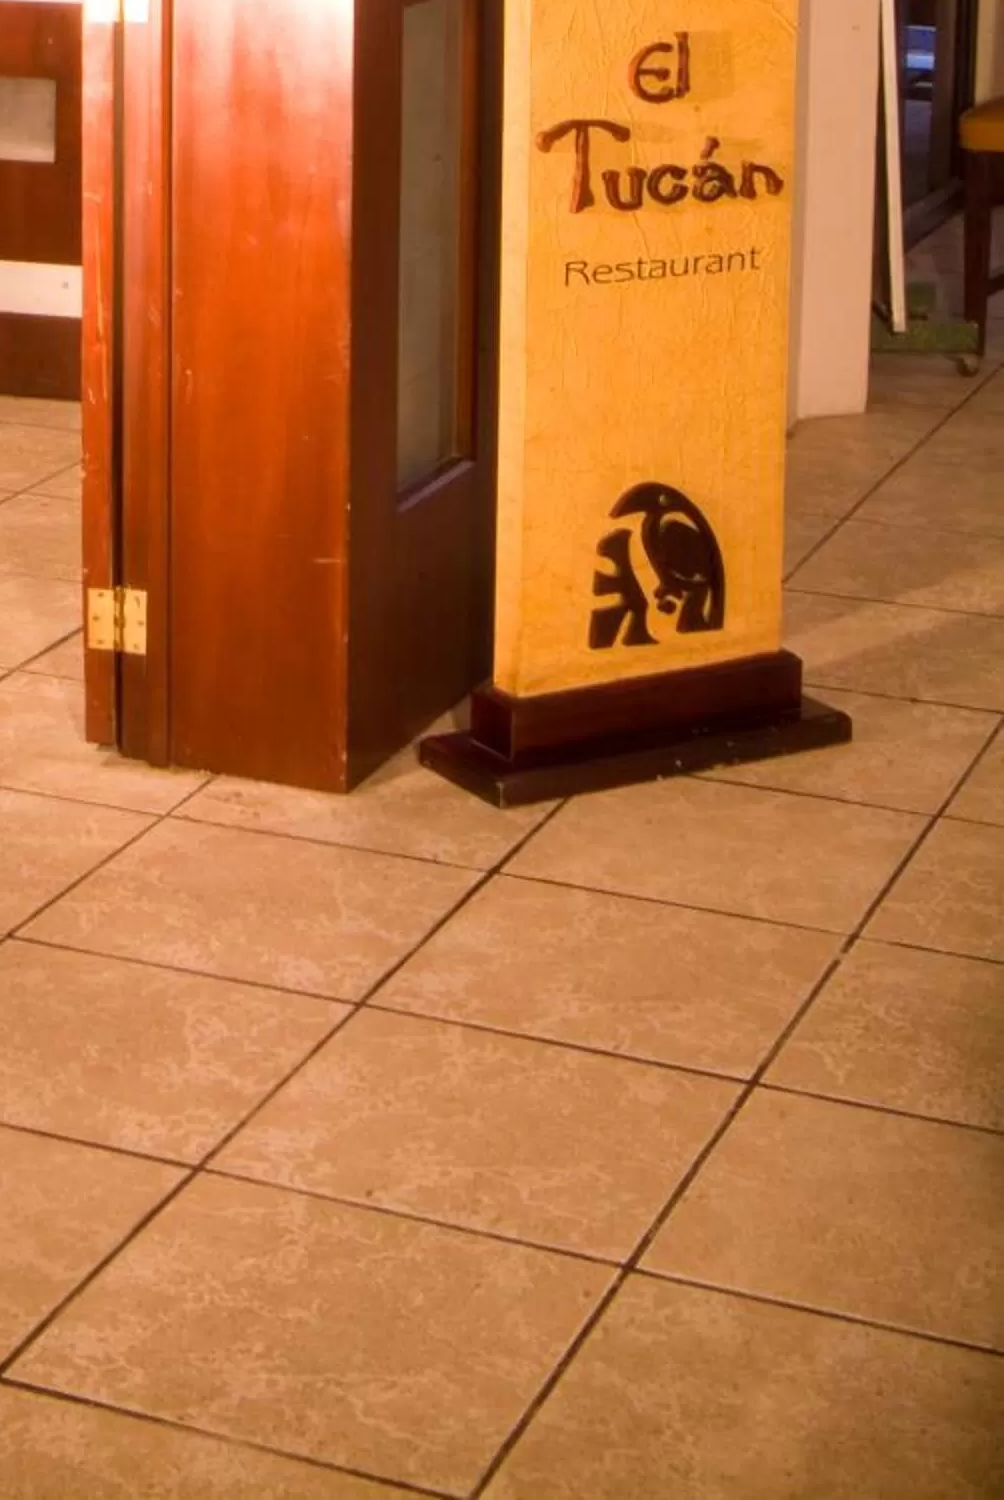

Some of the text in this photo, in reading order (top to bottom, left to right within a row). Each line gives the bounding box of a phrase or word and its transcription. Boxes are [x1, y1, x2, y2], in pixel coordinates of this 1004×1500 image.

[628, 31, 691, 104] El
[535, 119, 785, 213] Tucán
[564, 247, 762, 287] Restaurant
